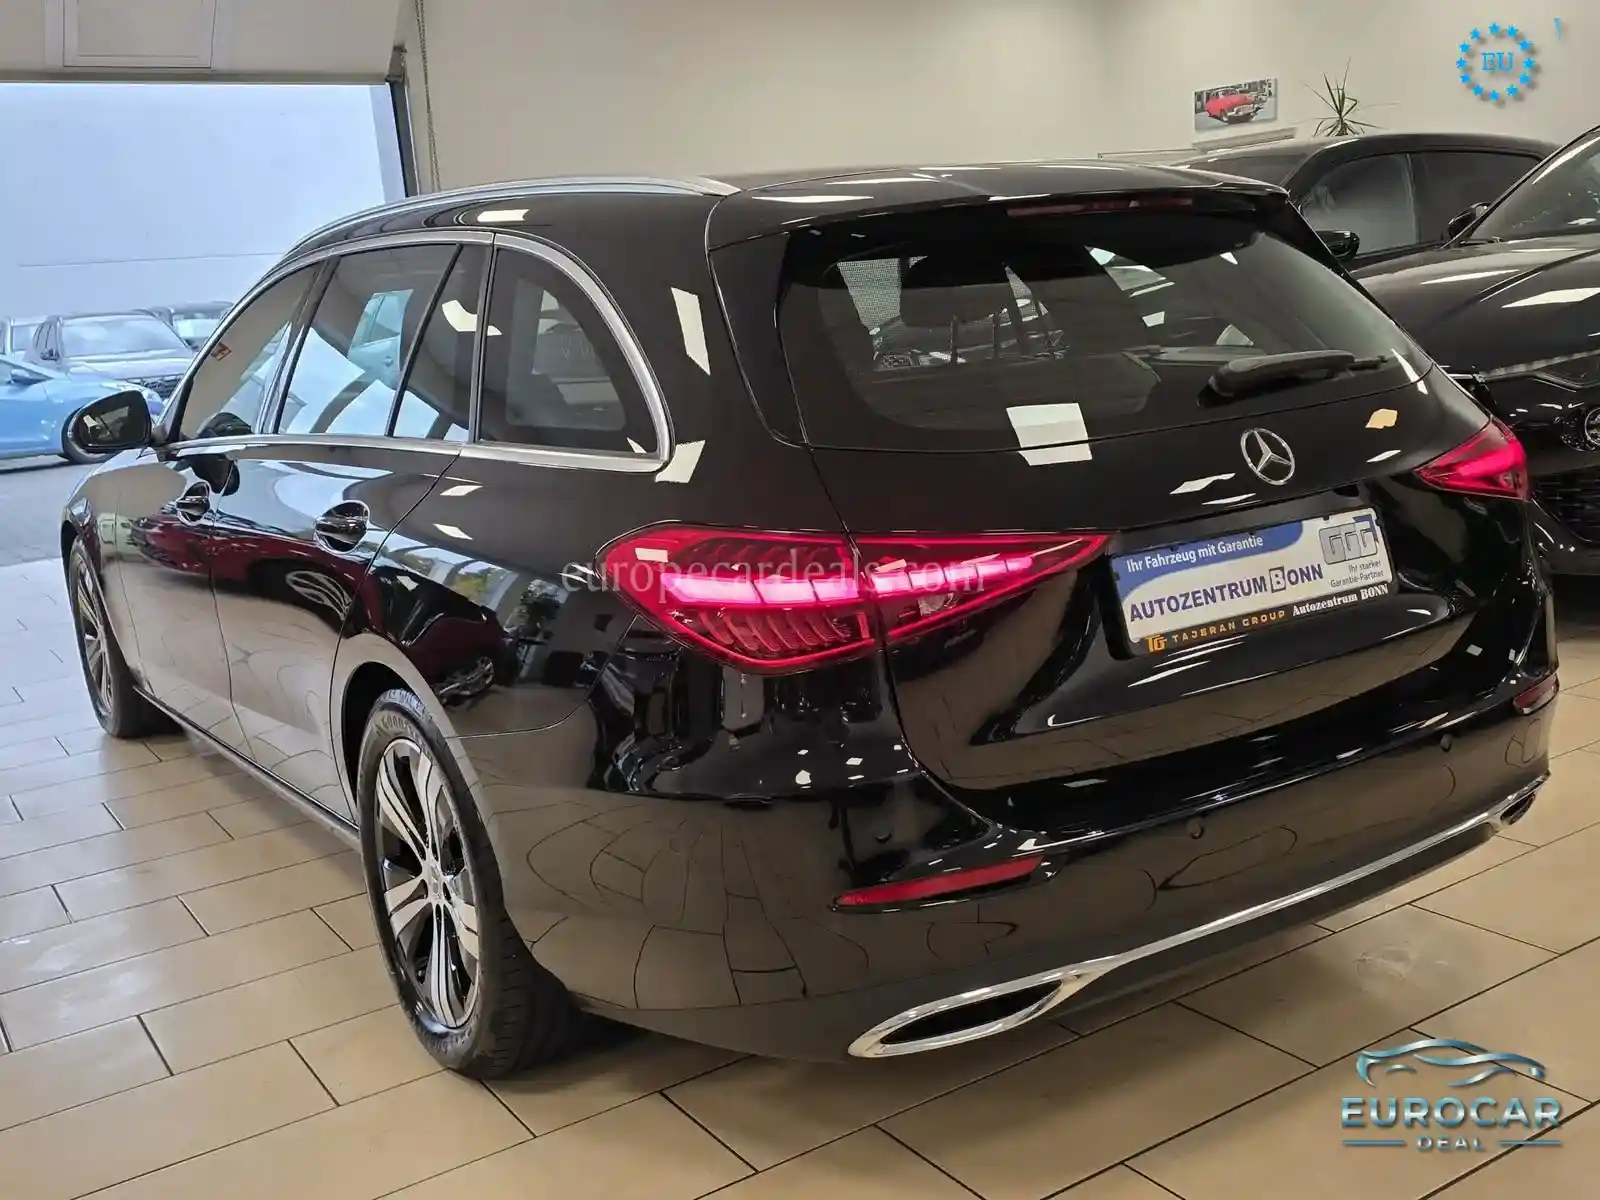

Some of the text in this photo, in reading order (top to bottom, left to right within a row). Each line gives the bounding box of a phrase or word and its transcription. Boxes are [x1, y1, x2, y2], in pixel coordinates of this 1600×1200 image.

[1126, 535, 1263, 573] Ihr Fahrzeug mit Garantie
[1130, 575, 1268, 622] AUTOZENTRUM
[1242, 609, 1285, 628] GROUP
[1292, 592, 1358, 617] Autozentrum
[1359, 583, 1389, 601] BONN
